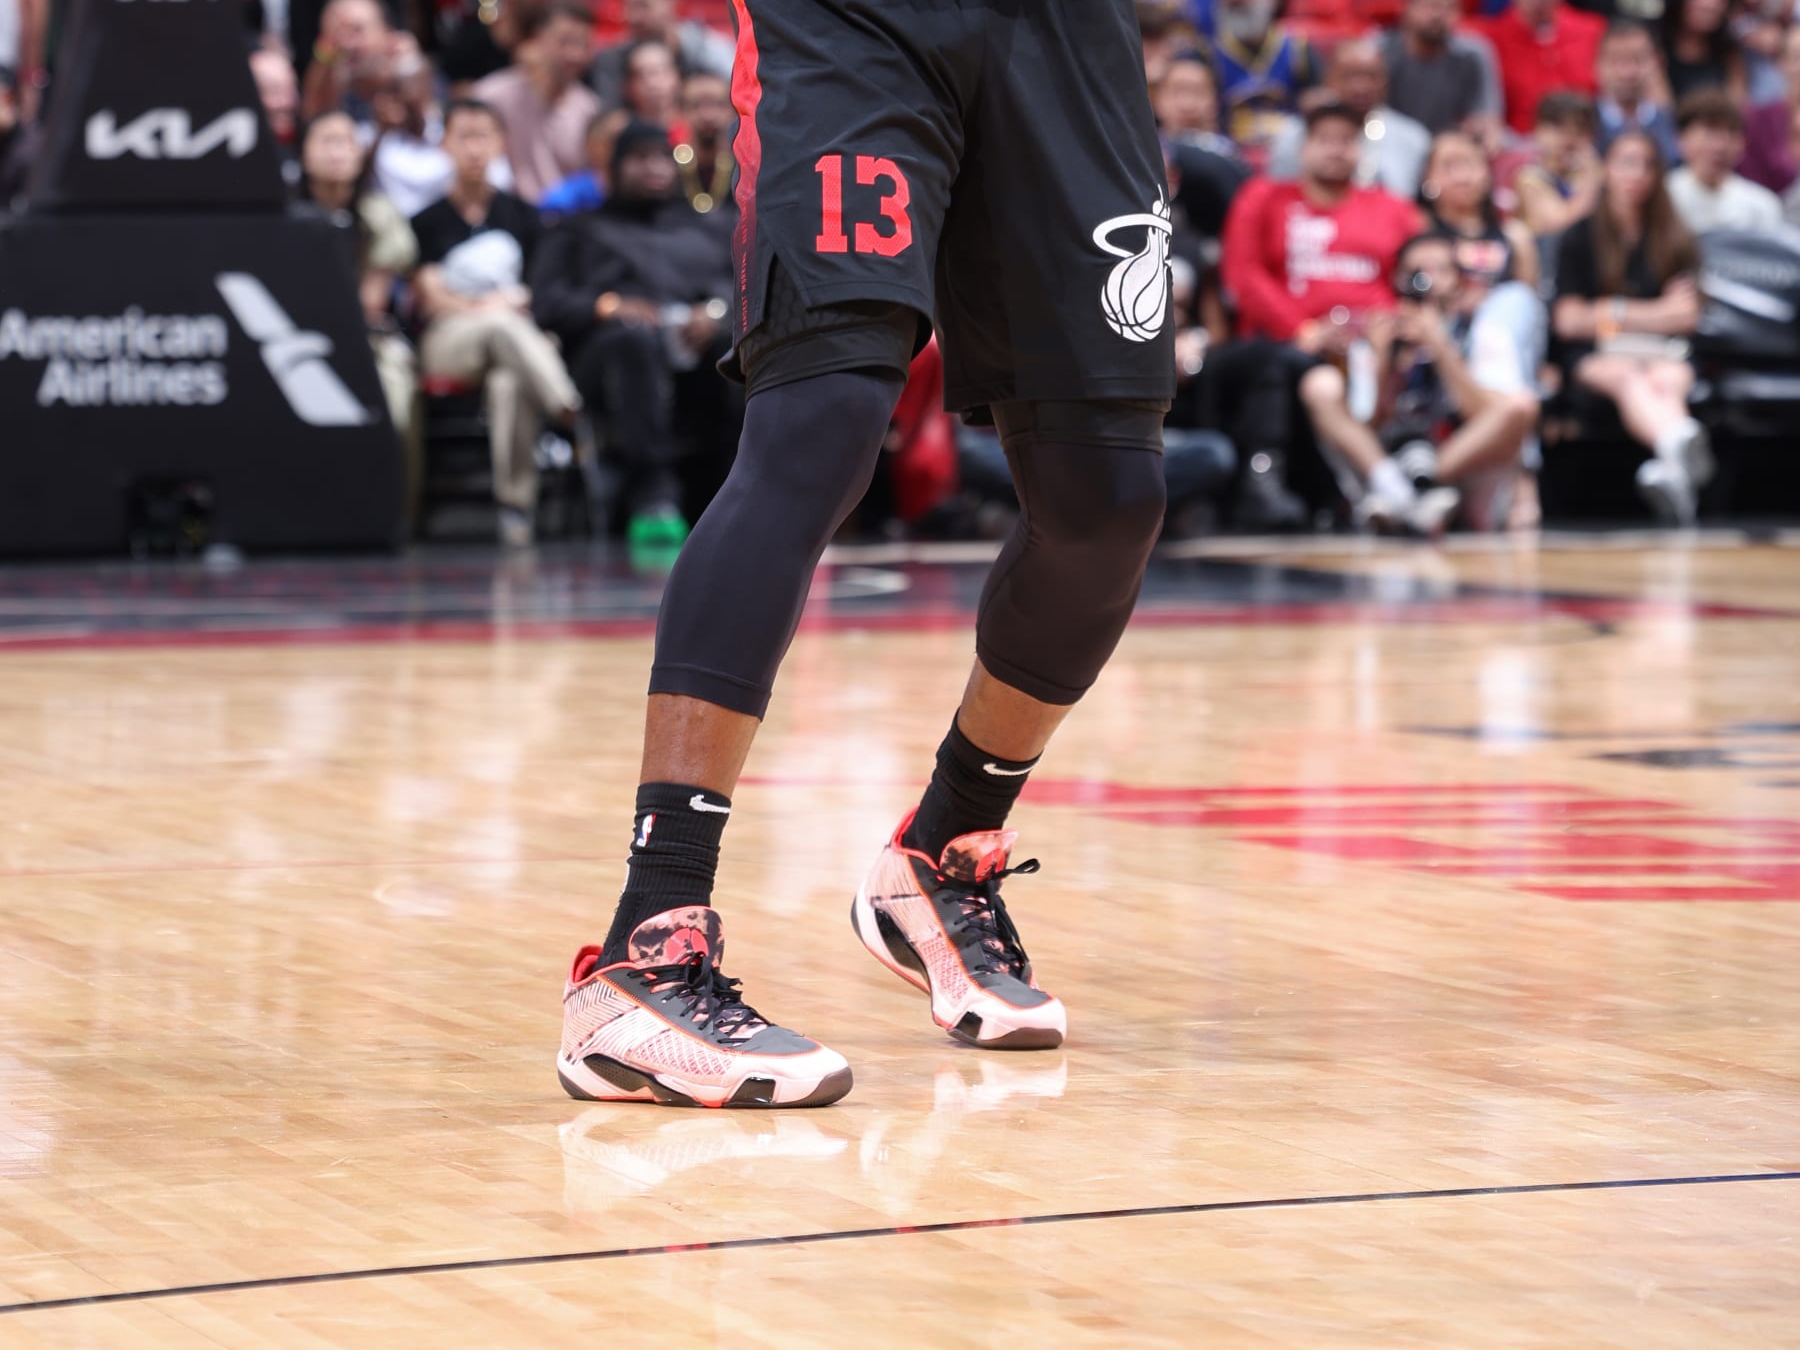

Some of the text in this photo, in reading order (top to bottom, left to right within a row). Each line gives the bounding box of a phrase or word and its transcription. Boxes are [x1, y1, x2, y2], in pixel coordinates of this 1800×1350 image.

[814, 153, 913, 258] 13
[0, 305, 229, 360] American
[36, 353, 229, 407] Airlines
